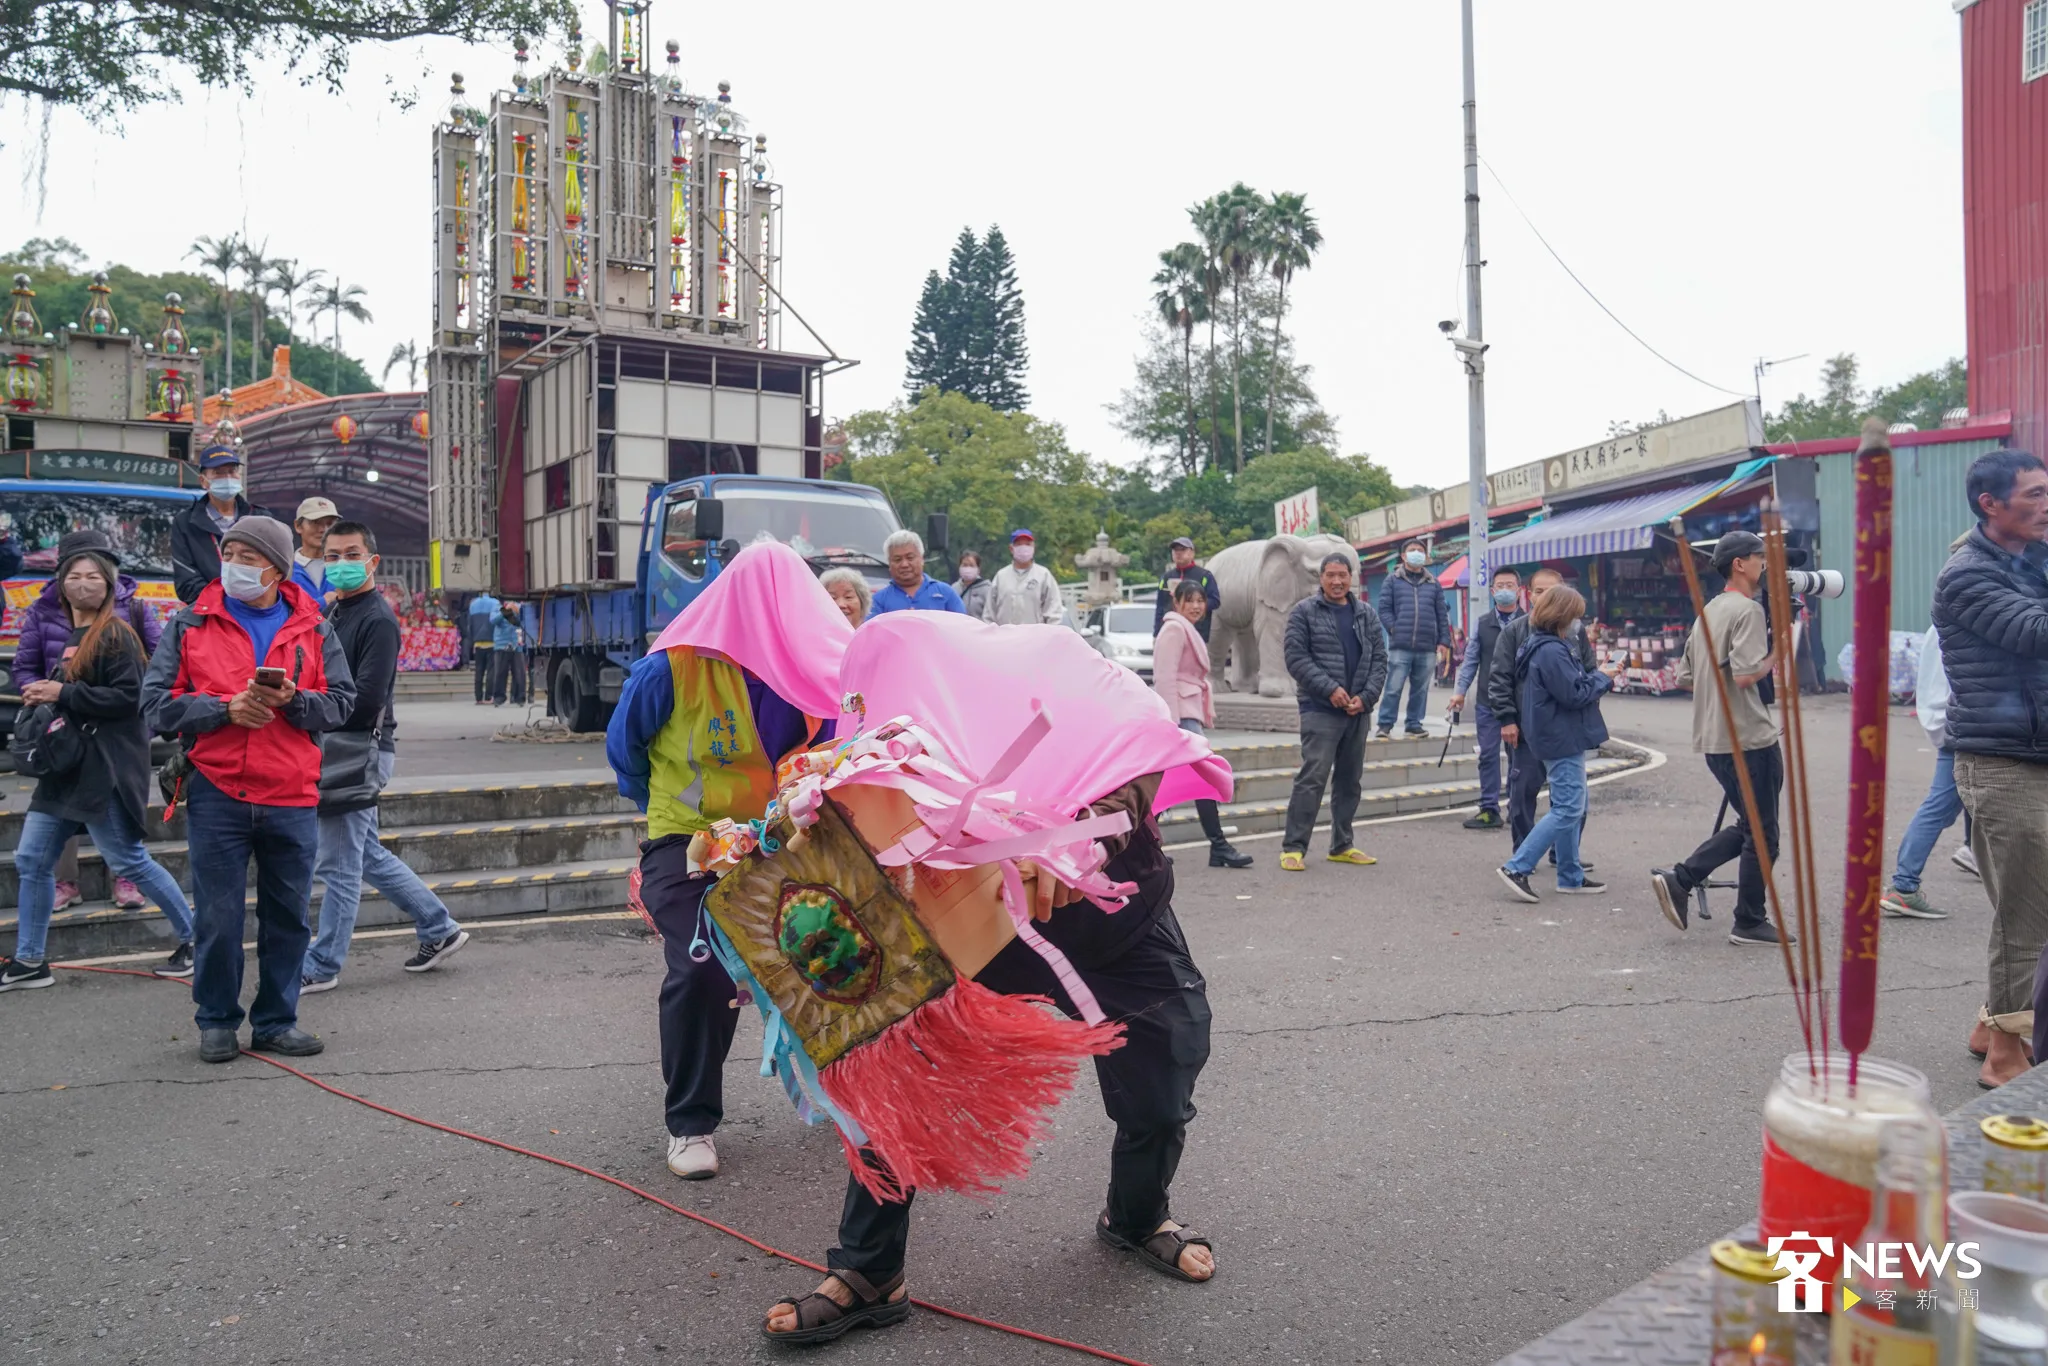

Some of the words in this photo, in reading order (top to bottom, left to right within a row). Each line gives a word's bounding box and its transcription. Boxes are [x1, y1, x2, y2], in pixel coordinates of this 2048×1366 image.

[451, 562, 463, 574] 左
[724, 709, 740, 752] 理事長
